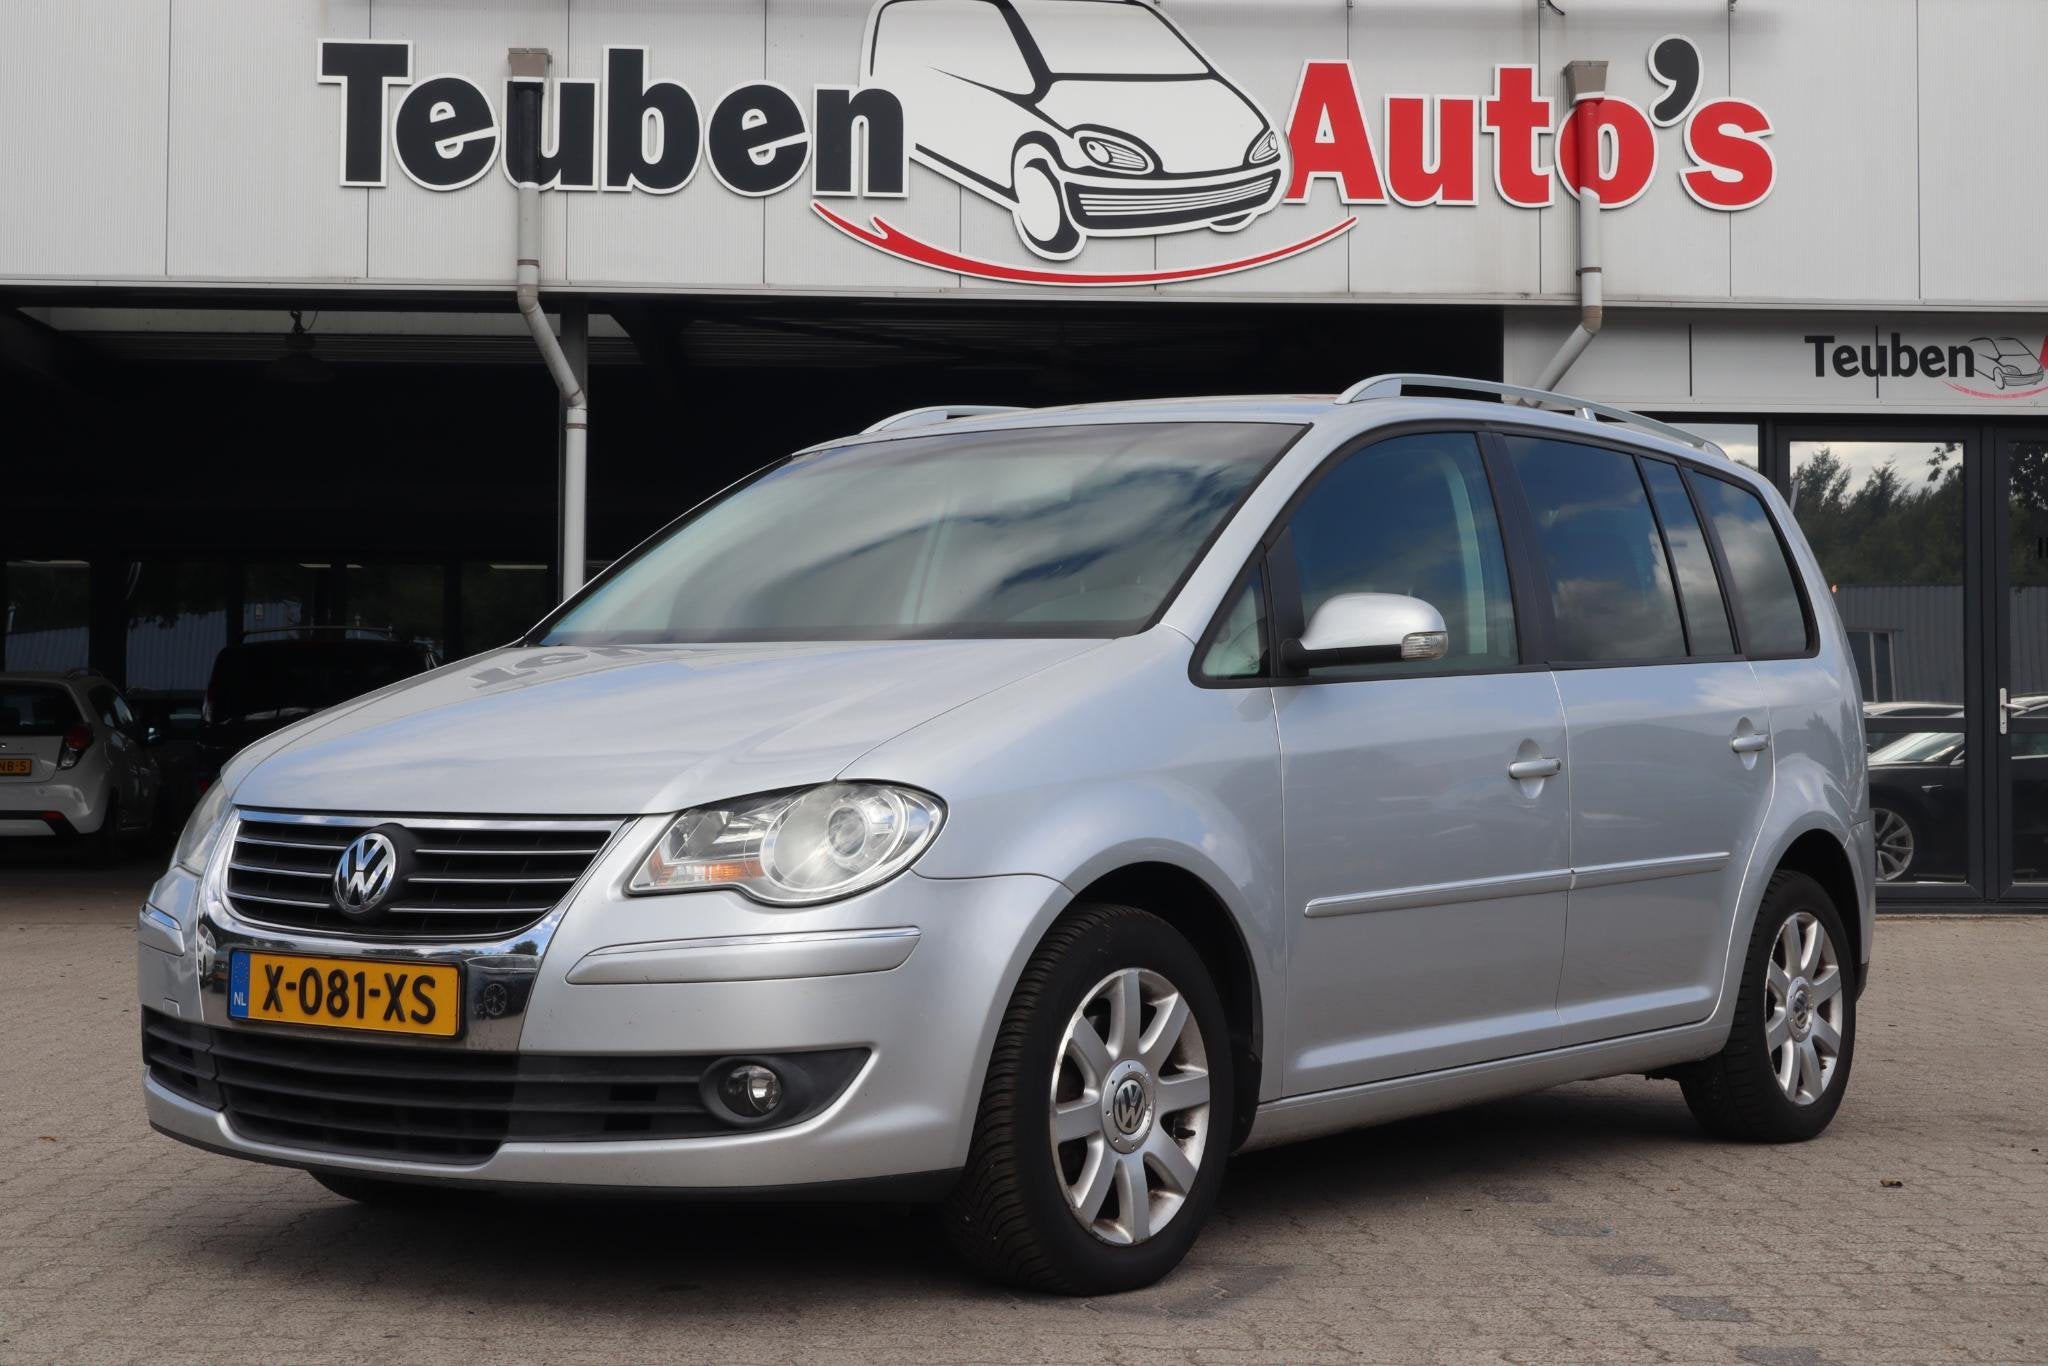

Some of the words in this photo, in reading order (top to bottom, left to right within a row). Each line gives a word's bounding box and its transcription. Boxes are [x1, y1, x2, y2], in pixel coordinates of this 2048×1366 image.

[320, 41, 908, 198] Teuben
[1284, 36, 1777, 210] Auto's
[1804, 332, 1975, 378] Teuben
[233, 991, 247, 1007] NL
[262, 963, 436, 1025] X-081-XS
